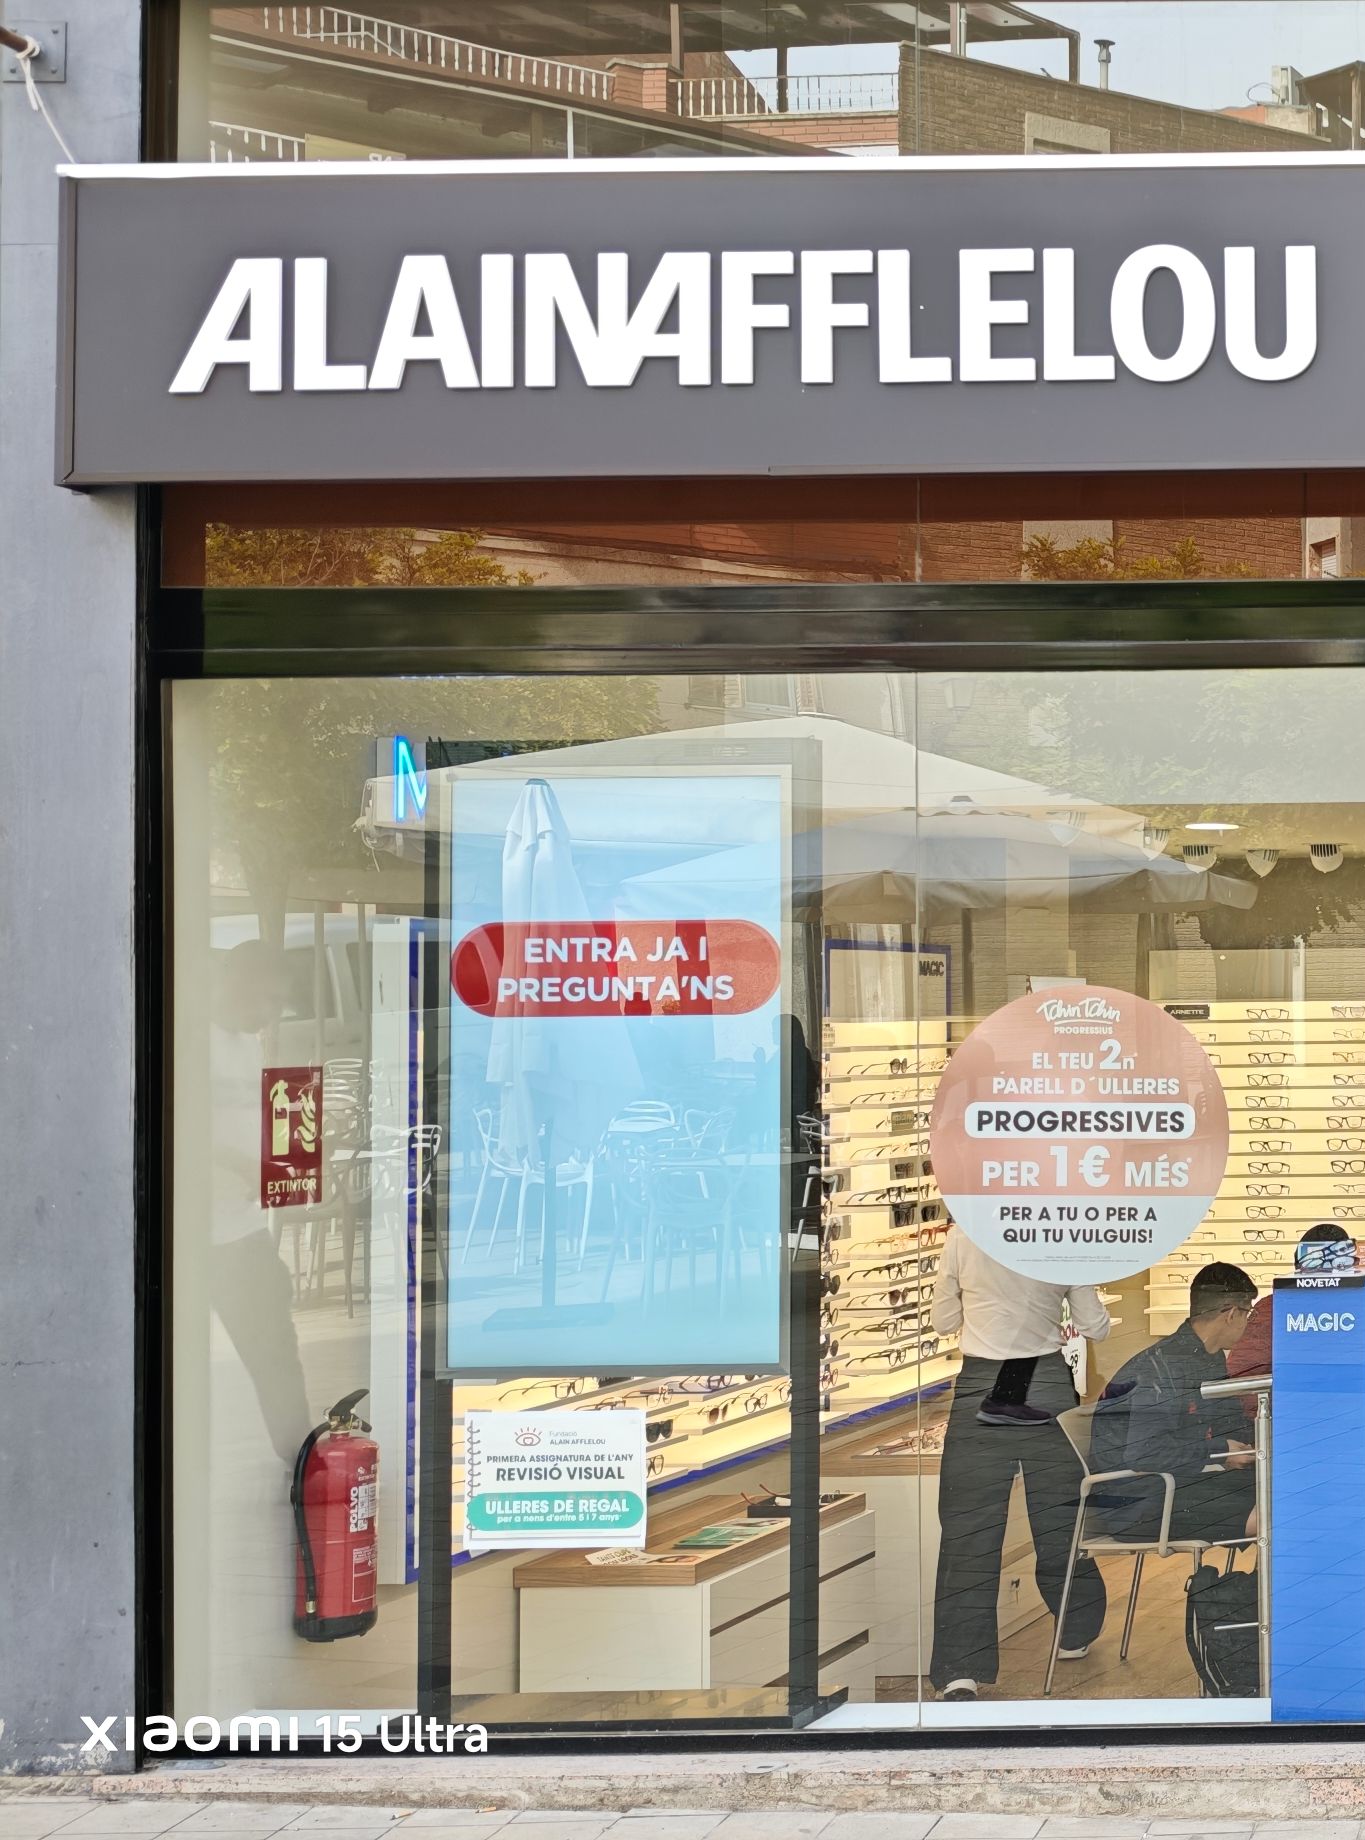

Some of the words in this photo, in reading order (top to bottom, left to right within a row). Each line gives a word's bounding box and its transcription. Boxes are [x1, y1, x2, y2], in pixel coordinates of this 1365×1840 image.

[524, 936, 638, 964] ENTRA
[646, 935, 688, 963] JA
[919, 960, 945, 977] MAGIC
[498, 974, 735, 1003] PREGUNTA'NS
[1036, 998, 1081, 1022] Tchin
[1078, 997, 1121, 1023] Tchin
[1053, 1026, 1113, 1035] PROGRESSIUS
[1032, 1052, 1053, 1070] EL
[1058, 1052, 1094, 1070] TEU
[992, 1077, 1065, 1095] PARELL
[977, 1110, 1186, 1132] PROGRESSIVES
[982, 1160, 1040, 1187] PER
[267, 1178, 317, 1194] EXTINTOR
[999, 1206, 1032, 1221] PER
[1037, 1206, 1052, 1221] A
[1056, 1206, 1079, 1221] TU
[1084, 1206, 1100, 1221] O
[1106, 1206, 1138, 1221] PER
[1143, 1206, 1158, 1222] A
[1002, 1229, 1037, 1244] QUI
[1042, 1228, 1064, 1243] TU
[1070, 1228, 1153, 1244] VULGUIS!
[1296, 1278, 1341, 1288] NOVETAT
[1286, 1312, 1356, 1332] MAGIC
[486, 1455, 527, 1463] PRIMERA
[529, 1454, 592, 1463] ASSIGNATURA
[594, 1454, 605, 1462] DE
[607, 1453, 634, 1462] L'ANY
[496, 1463, 563, 1482] REVISIÓ
[566, 1466, 625, 1480] VISUAL
[485, 1500, 550, 1515] ULLERES
[553, 1499, 574, 1514] DE
[578, 1498, 630, 1513] REGAL
[496, 1516, 514, 1524] per
[546, 1514, 577, 1523] d'entre
